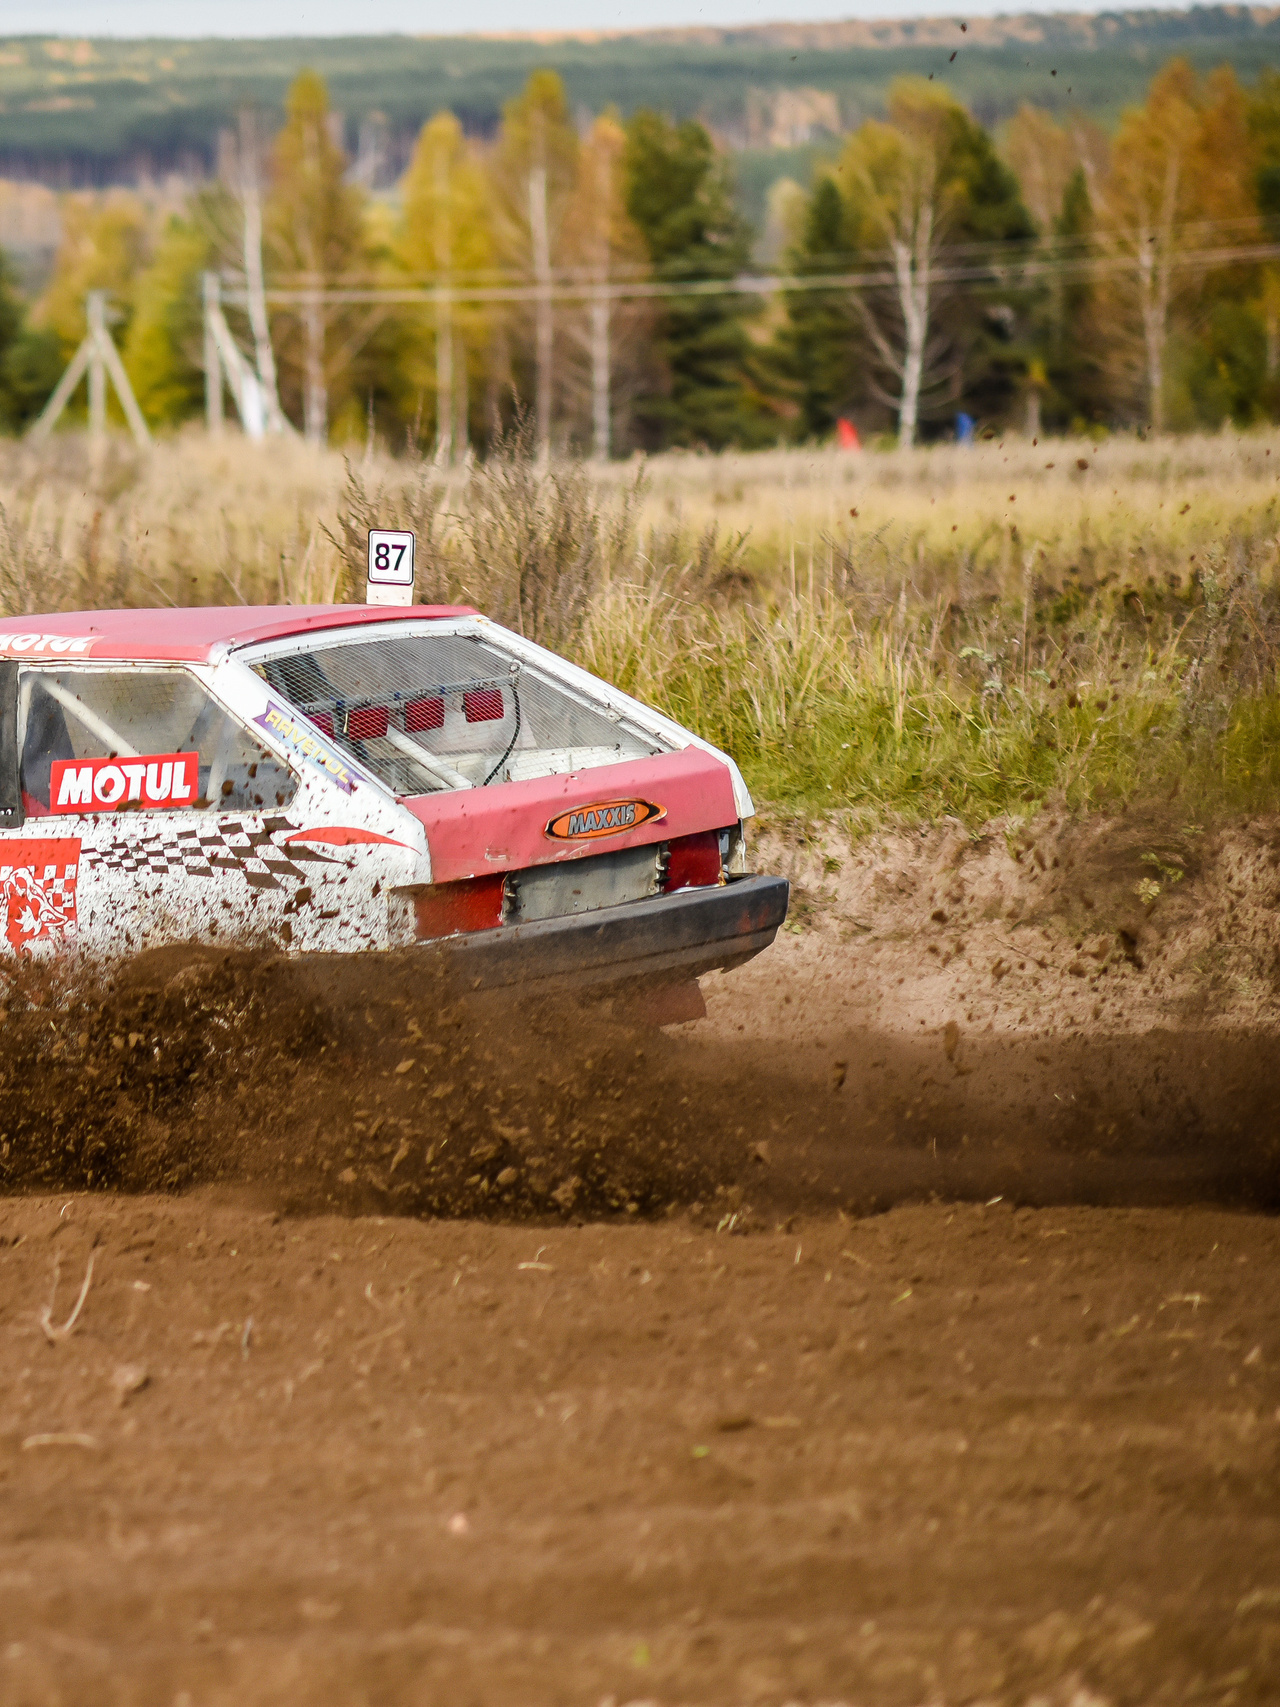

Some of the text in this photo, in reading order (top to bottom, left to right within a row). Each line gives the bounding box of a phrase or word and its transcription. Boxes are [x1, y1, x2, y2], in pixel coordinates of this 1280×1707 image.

[375, 543, 408, 571] 87
[56, 761, 192, 805] MOTUL
[567, 803, 635, 835] MAXXIS
